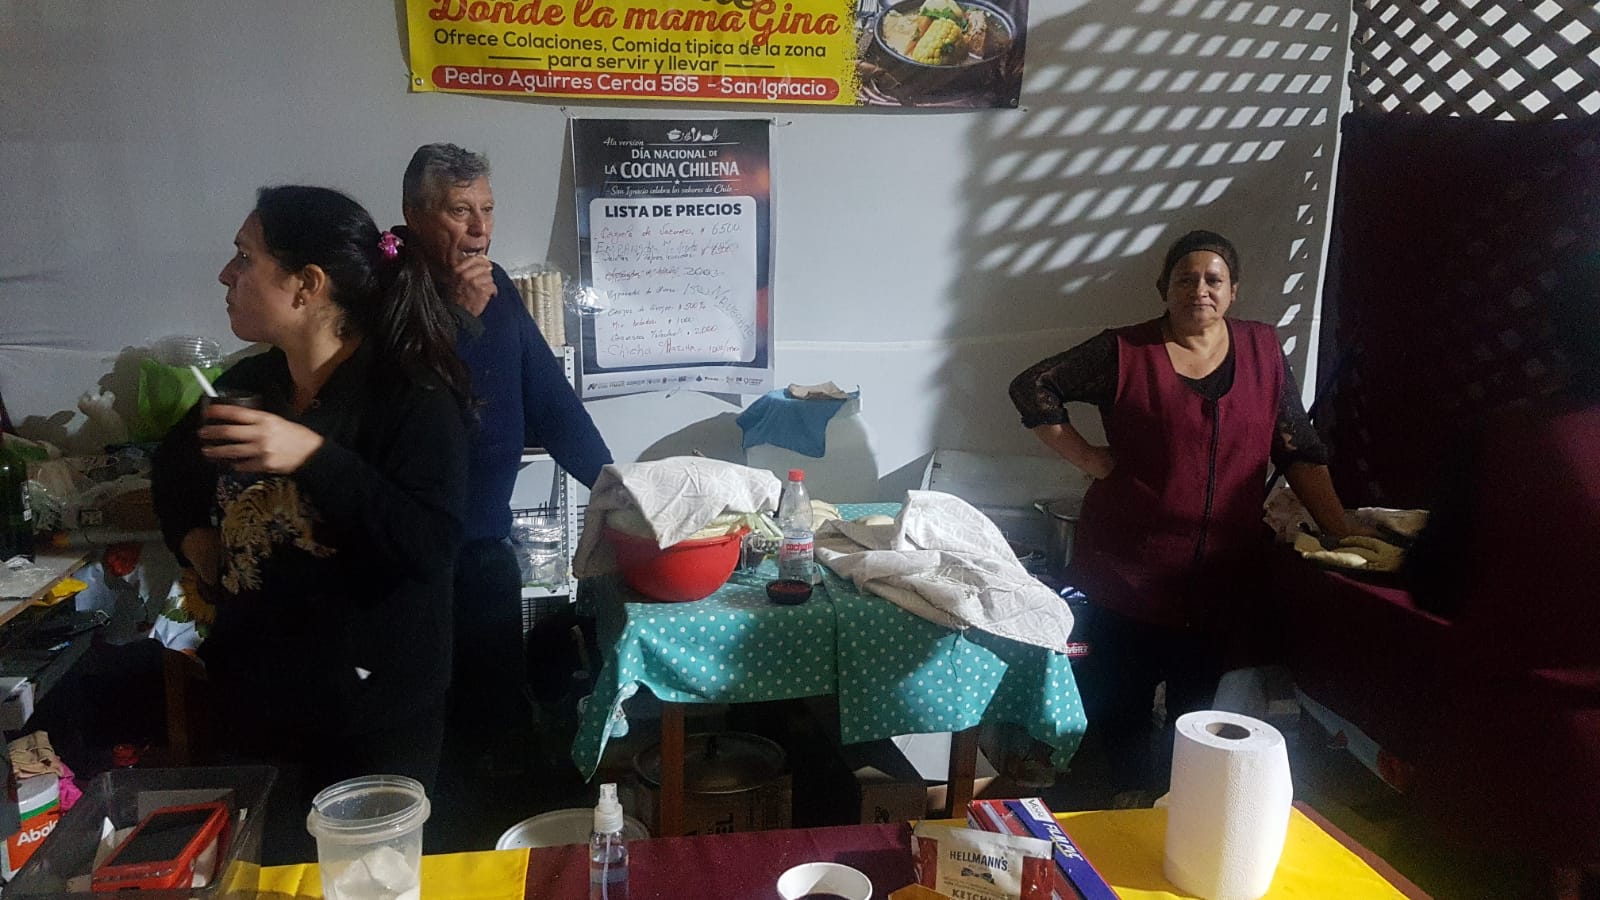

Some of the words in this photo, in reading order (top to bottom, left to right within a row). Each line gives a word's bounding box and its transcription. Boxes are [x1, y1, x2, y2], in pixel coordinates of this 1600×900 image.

[428, 0, 566, 27] Donde
[573, 0, 618, 29] la
[623, 7, 746, 32] mama
[749, 0, 841, 46] Gina
[434, 28, 499, 46] Ofrece
[503, 31, 608, 52] Colaciones,
[612, 36, 681, 54] Comida
[738, 41, 761, 56] de
[766, 42, 780, 57] la
[785, 45, 826, 57] zona
[548, 54, 592, 70] para
[596, 54, 650, 69] servir
[655, 59, 664, 73] y
[669, 56, 719, 71] llevar
[445, 67, 504, 86] Pedro
[508, 70, 593, 93] Aguirres
[597, 74, 656, 92] Cerda
[661, 75, 699, 92] 565
[720, 77, 757, 94] San
[763, 78, 827, 99] Ignacio
[654, 149, 707, 159] NACIONAL
[604, 165, 617, 175] LA
[620, 161, 676, 178] COCINA
[678, 161, 740, 178] CHILENA
[605, 205, 649, 218] LISTA
[652, 204, 672, 217] DE
[676, 203, 742, 217] PRECIOS
[949, 851, 1009, 871] HELLMANN'S
